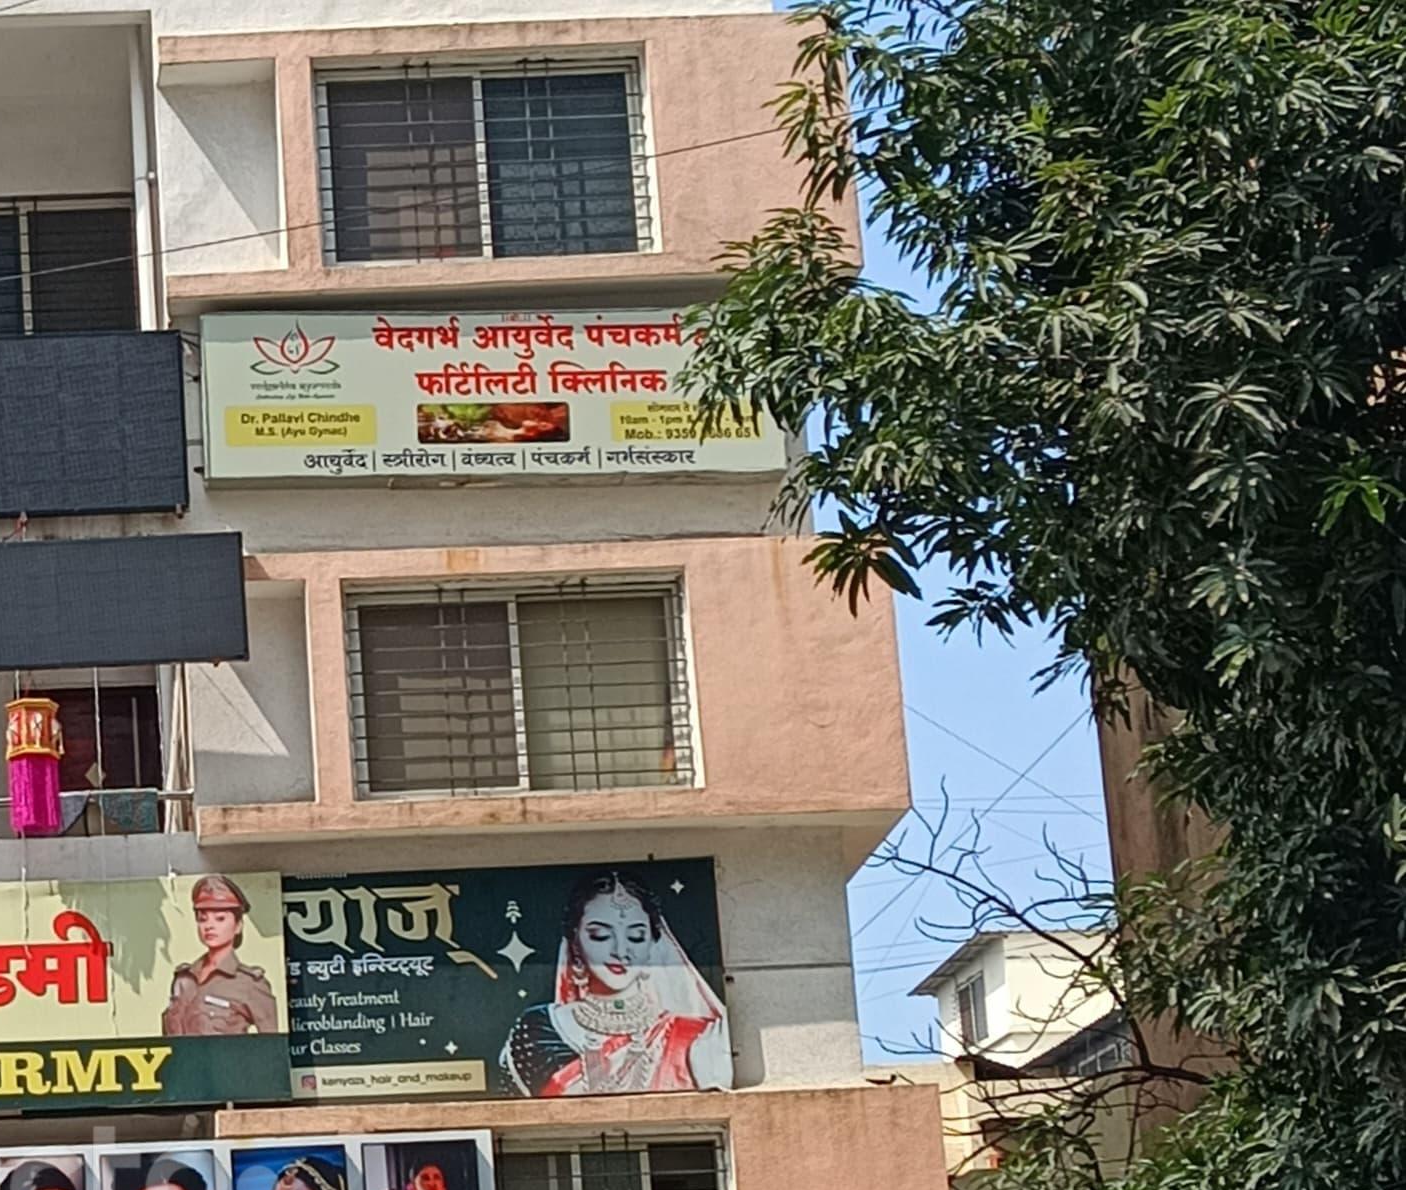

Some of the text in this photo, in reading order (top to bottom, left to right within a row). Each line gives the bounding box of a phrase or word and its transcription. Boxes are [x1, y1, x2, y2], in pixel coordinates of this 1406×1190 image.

[372, 314, 683, 359] वेदगर्भ आयुर्वेद पंचकर्म
[416, 361, 667, 396] फर्टिलिटी क्लिनिक
[241, 412, 361, 424] Dr. Pallavi Chindhe
[304, 447, 369, 474] आयुर्वेद
[381, 446, 448, 470] स्त्रीरोग
[307, 953, 345, 981] ब्युटी
[290, 990, 401, 1012] eauty Treatment
[292, 1012, 435, 1034] icroblanding Hair
[310, 1037, 362, 1056] Classes
